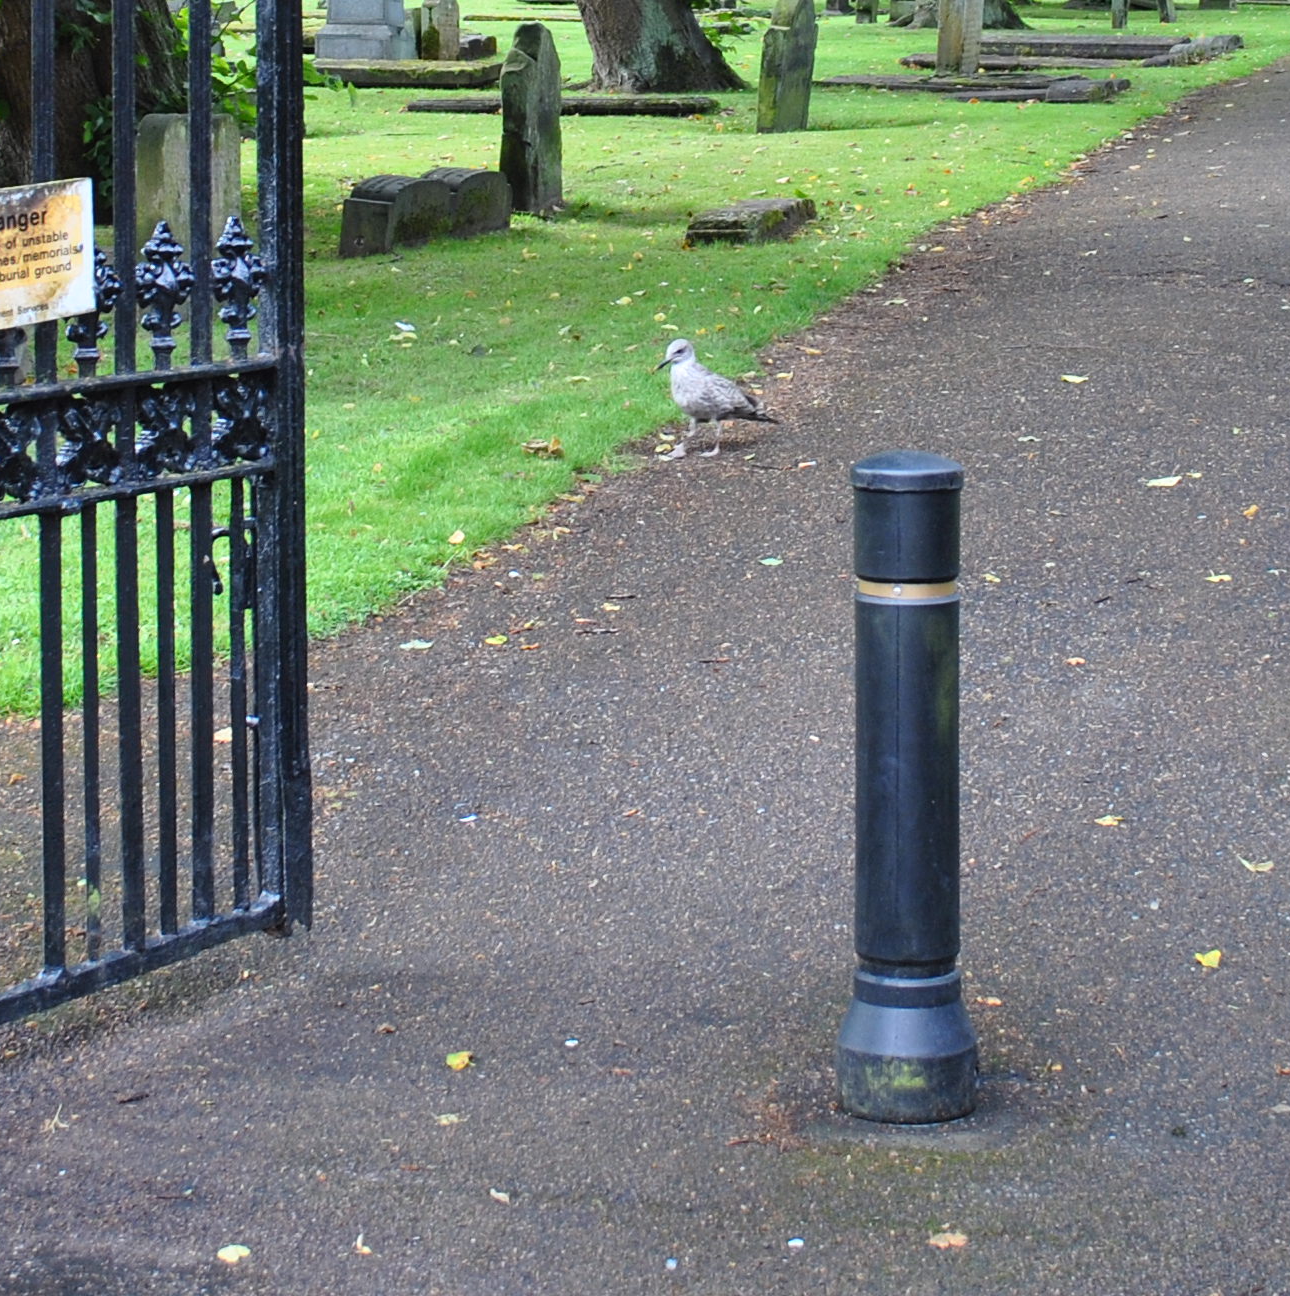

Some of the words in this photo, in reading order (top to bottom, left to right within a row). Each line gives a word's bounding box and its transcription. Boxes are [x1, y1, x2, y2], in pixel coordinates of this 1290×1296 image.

[5, 238, 17, 250] of
[21, 230, 69, 247] unstable
[0, 267, 30, 283] burial
[34, 261, 72, 278] ground
[17, 303, 50, 315] Services
